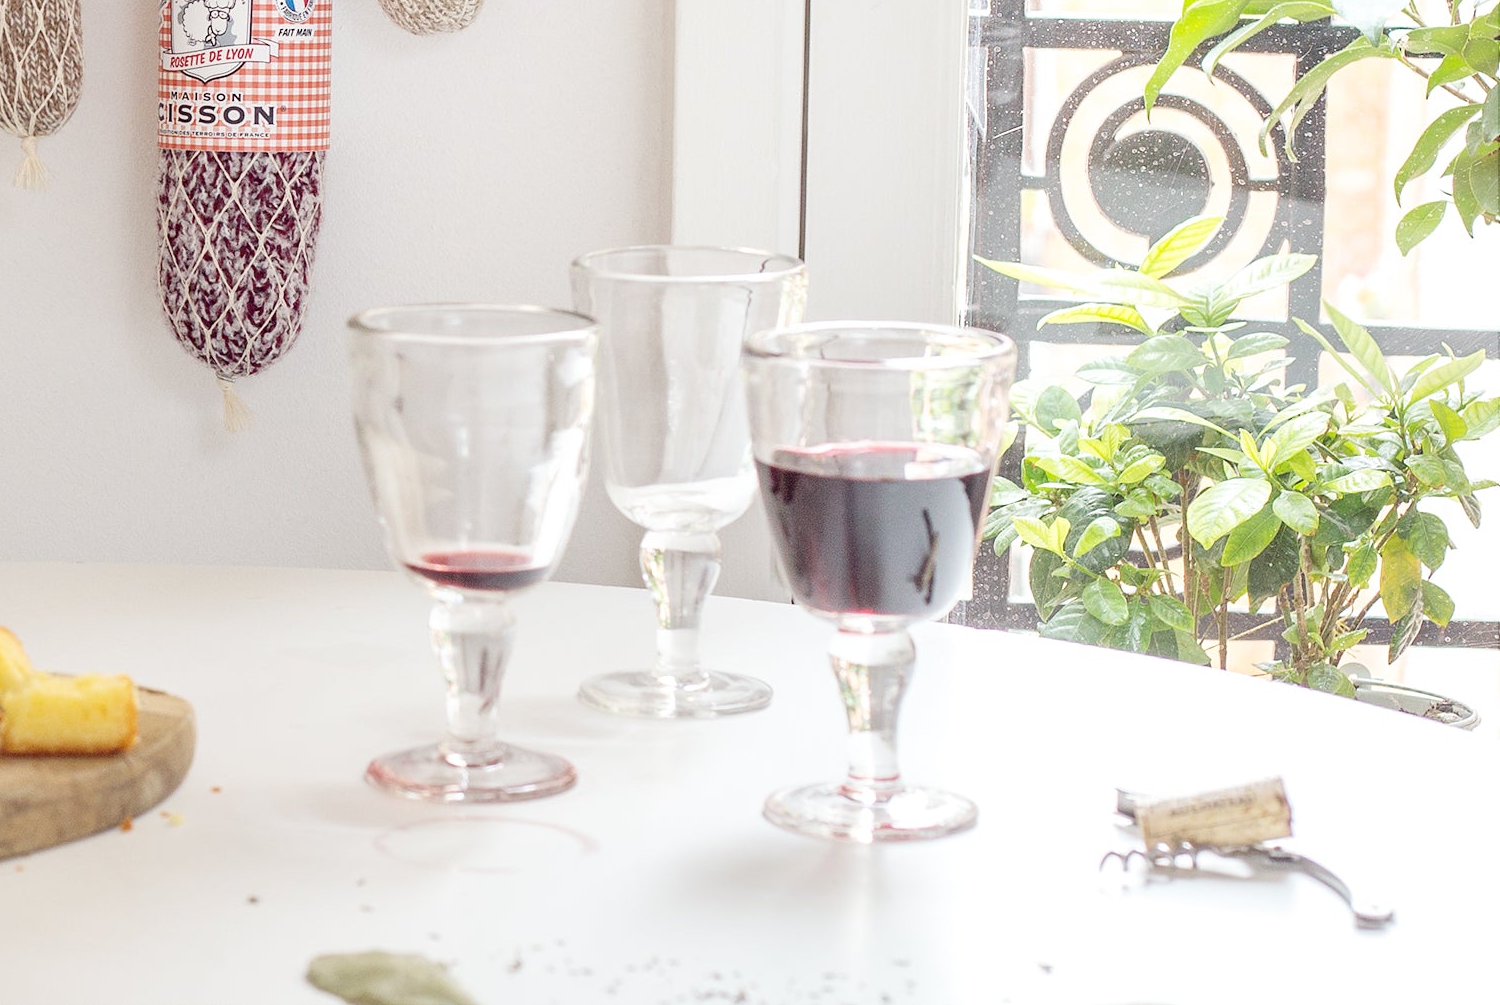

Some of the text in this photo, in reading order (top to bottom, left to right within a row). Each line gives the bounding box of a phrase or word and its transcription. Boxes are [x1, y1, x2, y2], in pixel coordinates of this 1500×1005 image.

[277, 27, 314, 38] FAIT MAIN
[169, 47, 255, 69] ROSETTE DE LYON
[170, 91, 242, 102] MAISON
